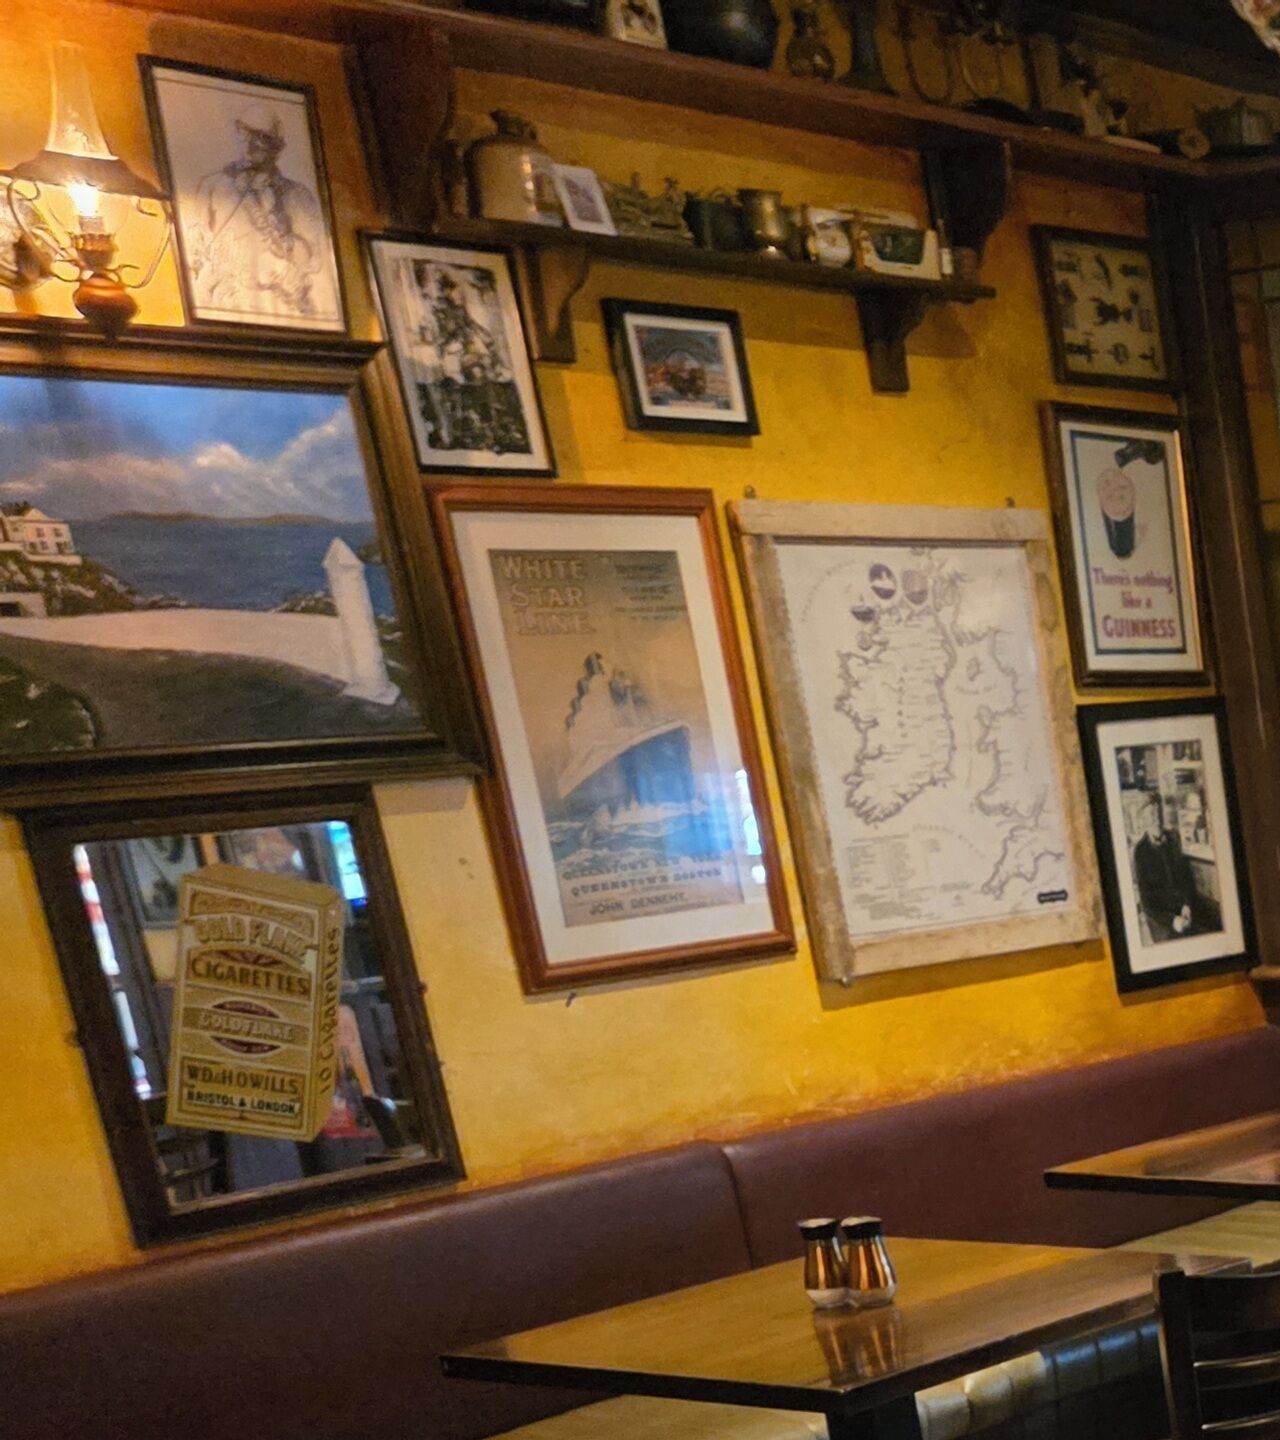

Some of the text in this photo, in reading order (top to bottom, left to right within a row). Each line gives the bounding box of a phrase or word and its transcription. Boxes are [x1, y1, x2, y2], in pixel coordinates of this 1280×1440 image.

[499, 556, 584, 580] WHITE
[511, 583, 585, 610] STAR
[1102, 614, 1176, 638] GUINNESS
[190, 957, 310, 997] CIGARETTES
[186, 1088, 235, 1107] BRISTOL
[250, 1098, 297, 1115] LONDON
